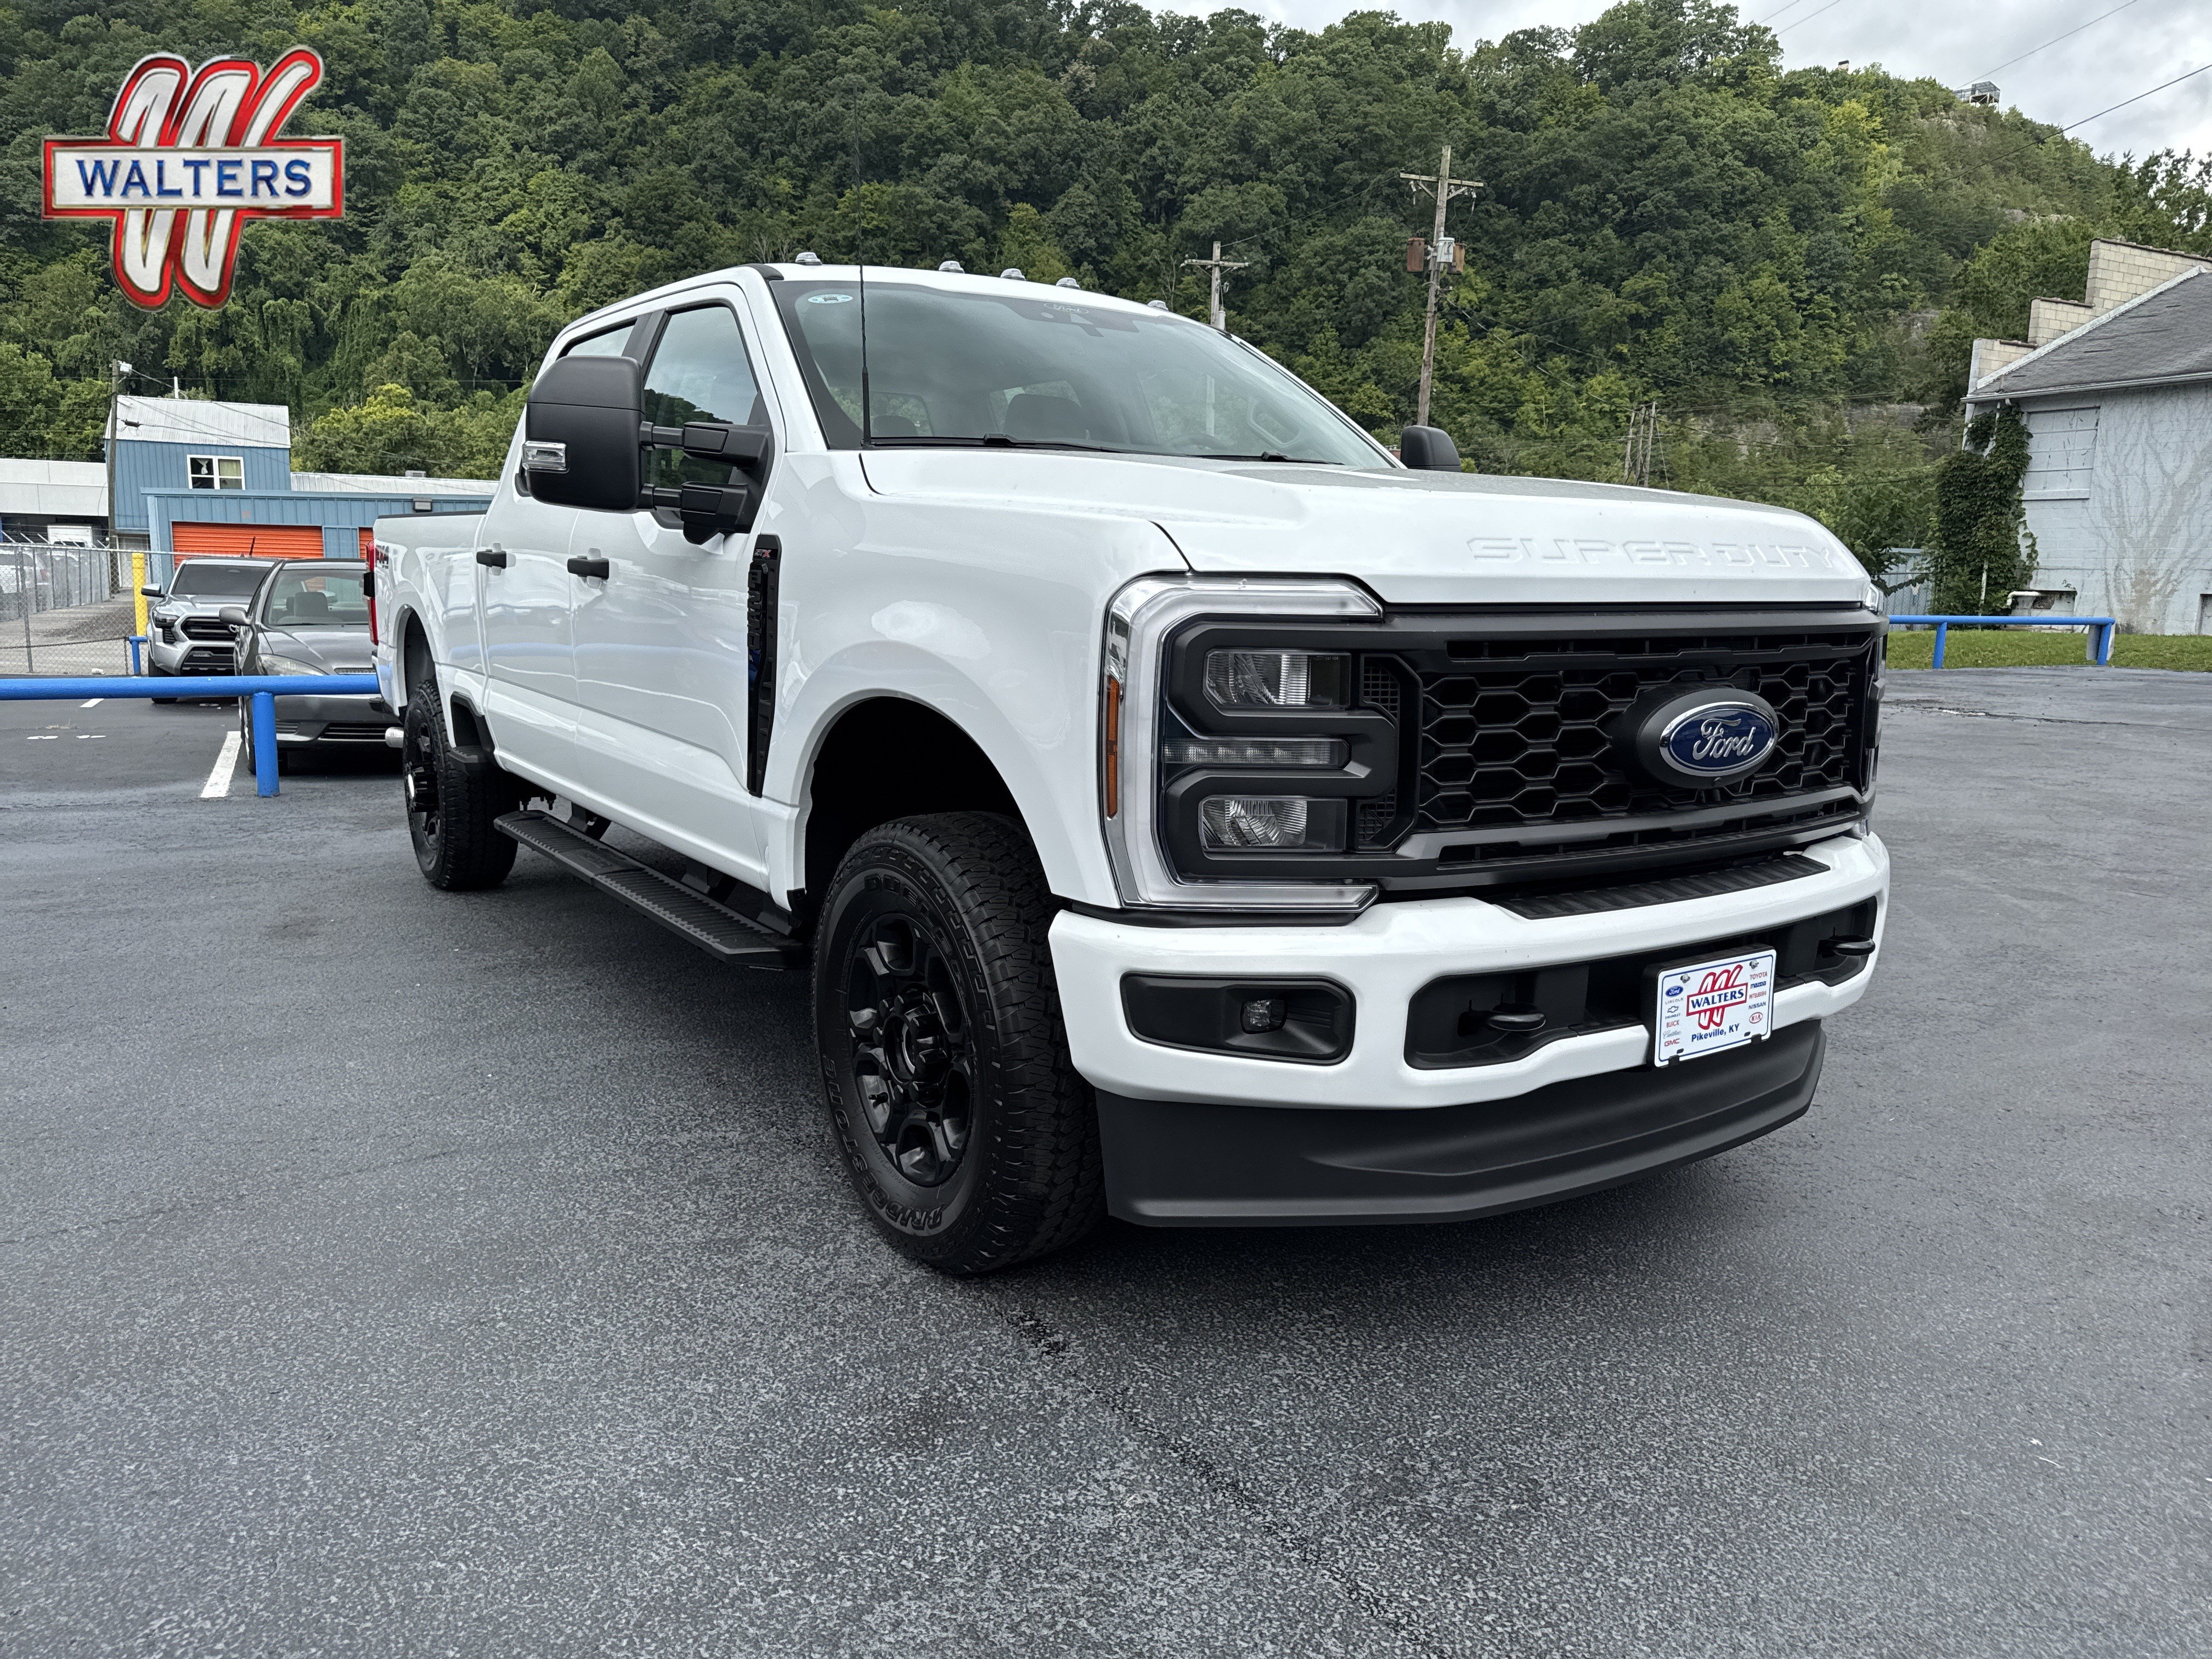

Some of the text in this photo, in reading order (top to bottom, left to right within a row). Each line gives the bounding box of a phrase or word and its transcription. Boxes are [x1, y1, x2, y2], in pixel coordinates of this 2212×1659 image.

[1053, 303, 1082, 313] Ford
[1466, 537, 1833, 568] SUPER DUTY
[1692, 718, 1756, 760] Ford
[1750, 971, 1768, 980] TOYOTA
[1691, 988, 1744, 1009] WALTERS
[1748, 1001, 1767, 1009] NISSAN
[1667, 1019, 1680, 1028] BUICK
[1691, 1023, 1740, 1042] Pikeville, KY
[1664, 1038, 1680, 1047] GMC
[823, 1054, 946, 1231] BRIDGESTONE
